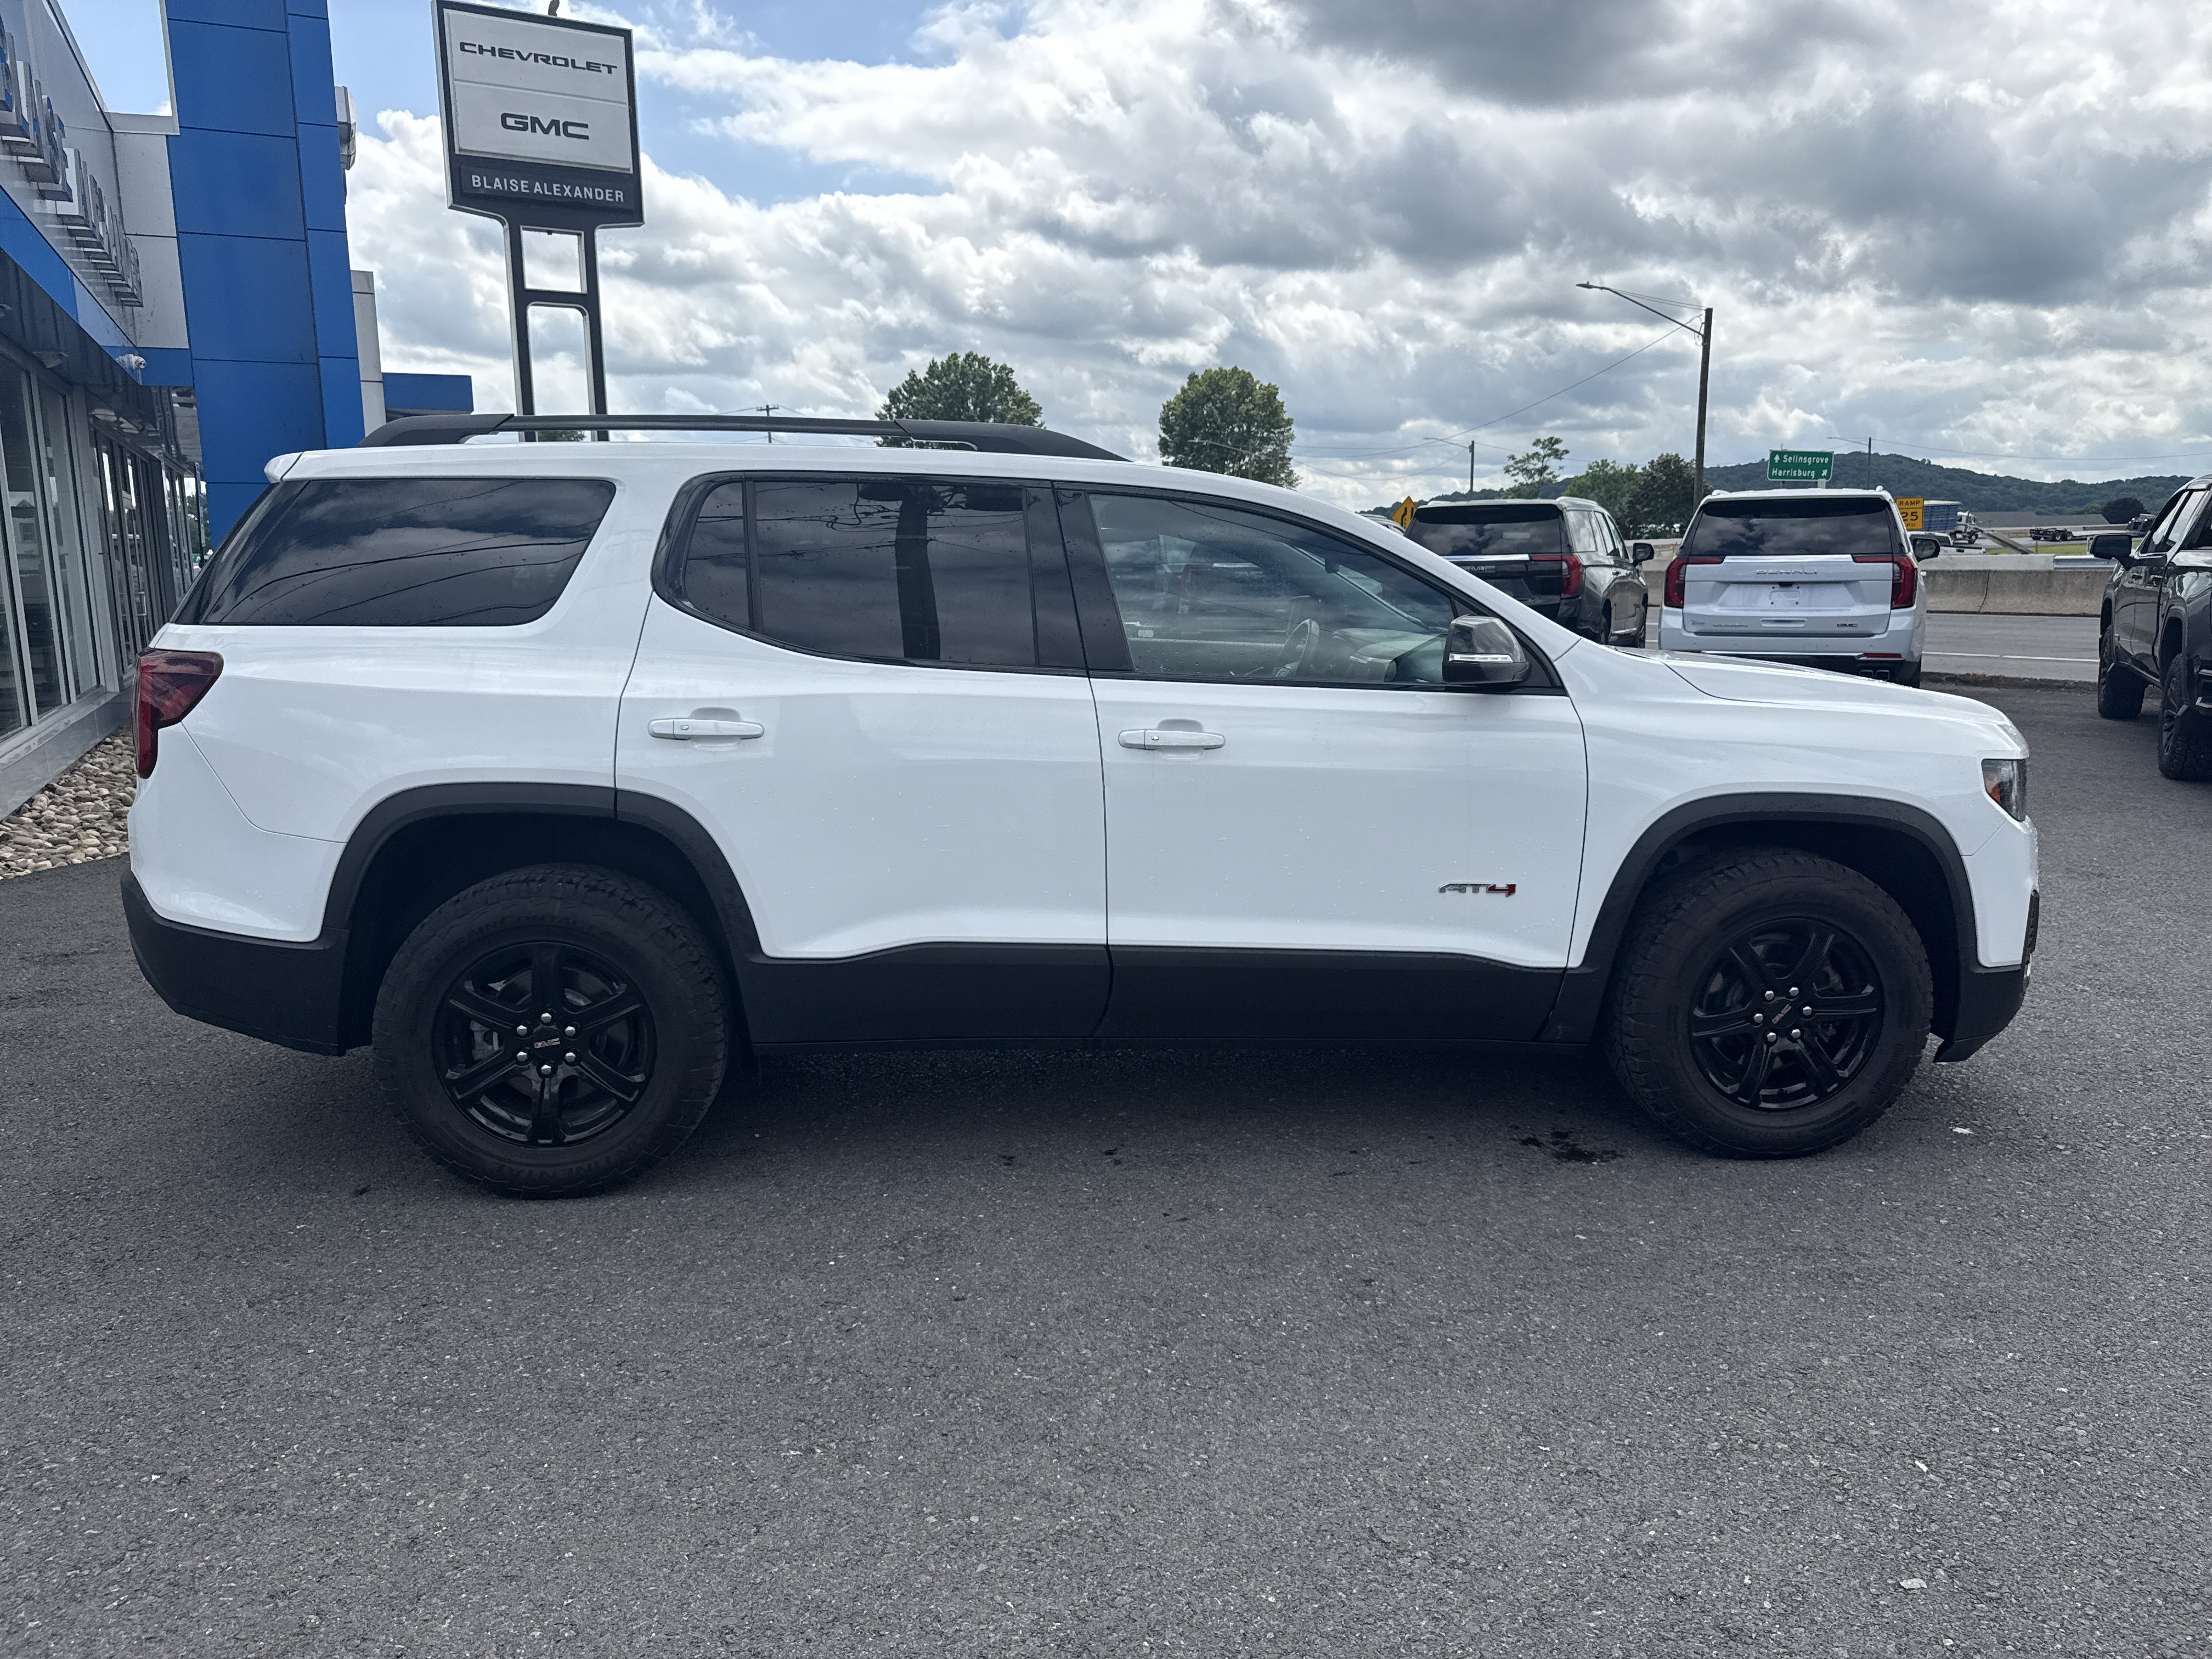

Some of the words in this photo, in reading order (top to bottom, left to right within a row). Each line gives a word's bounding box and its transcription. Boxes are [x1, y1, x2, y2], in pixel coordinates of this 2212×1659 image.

[460, 41, 617, 75] CHEVROLET
[501, 112, 589, 140] GMC
[472, 174, 530, 193] BLAISE
[533, 182, 624, 203] ALEXANDER
[1782, 454, 1829, 465] Selinsgrove
[1771, 468, 1815, 478] Harrisburg
[1900, 511, 1918, 521] 25
[1771, 1003, 1792, 1024] GMC
[533, 1037, 561, 1049] GMC
